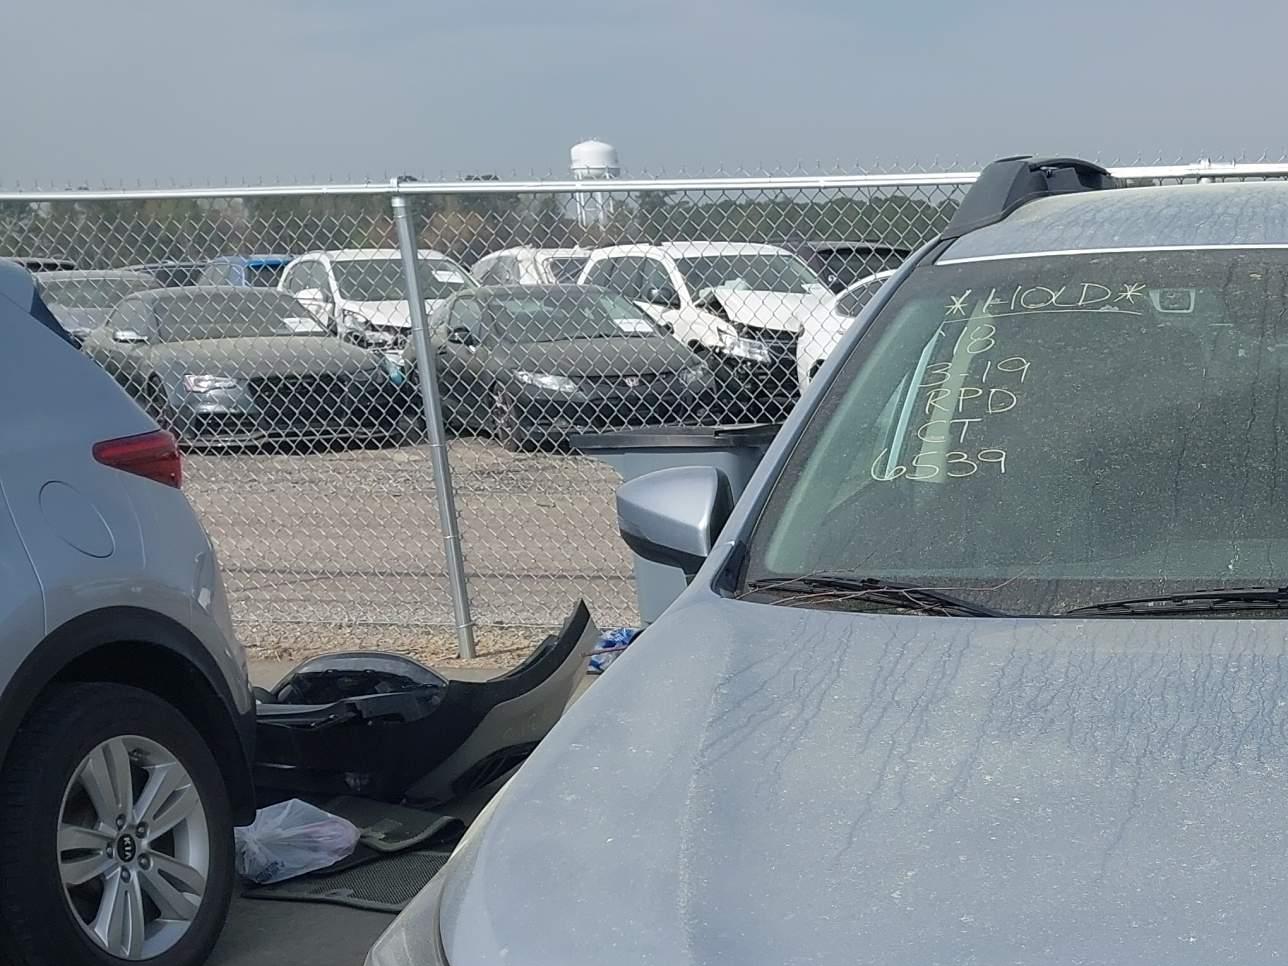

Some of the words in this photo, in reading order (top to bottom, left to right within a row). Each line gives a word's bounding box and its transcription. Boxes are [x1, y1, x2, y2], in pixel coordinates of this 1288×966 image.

[917, 356, 1031, 388] 3-19
[925, 387, 1018, 415] RPD
[870, 447, 1007, 482] 6539
